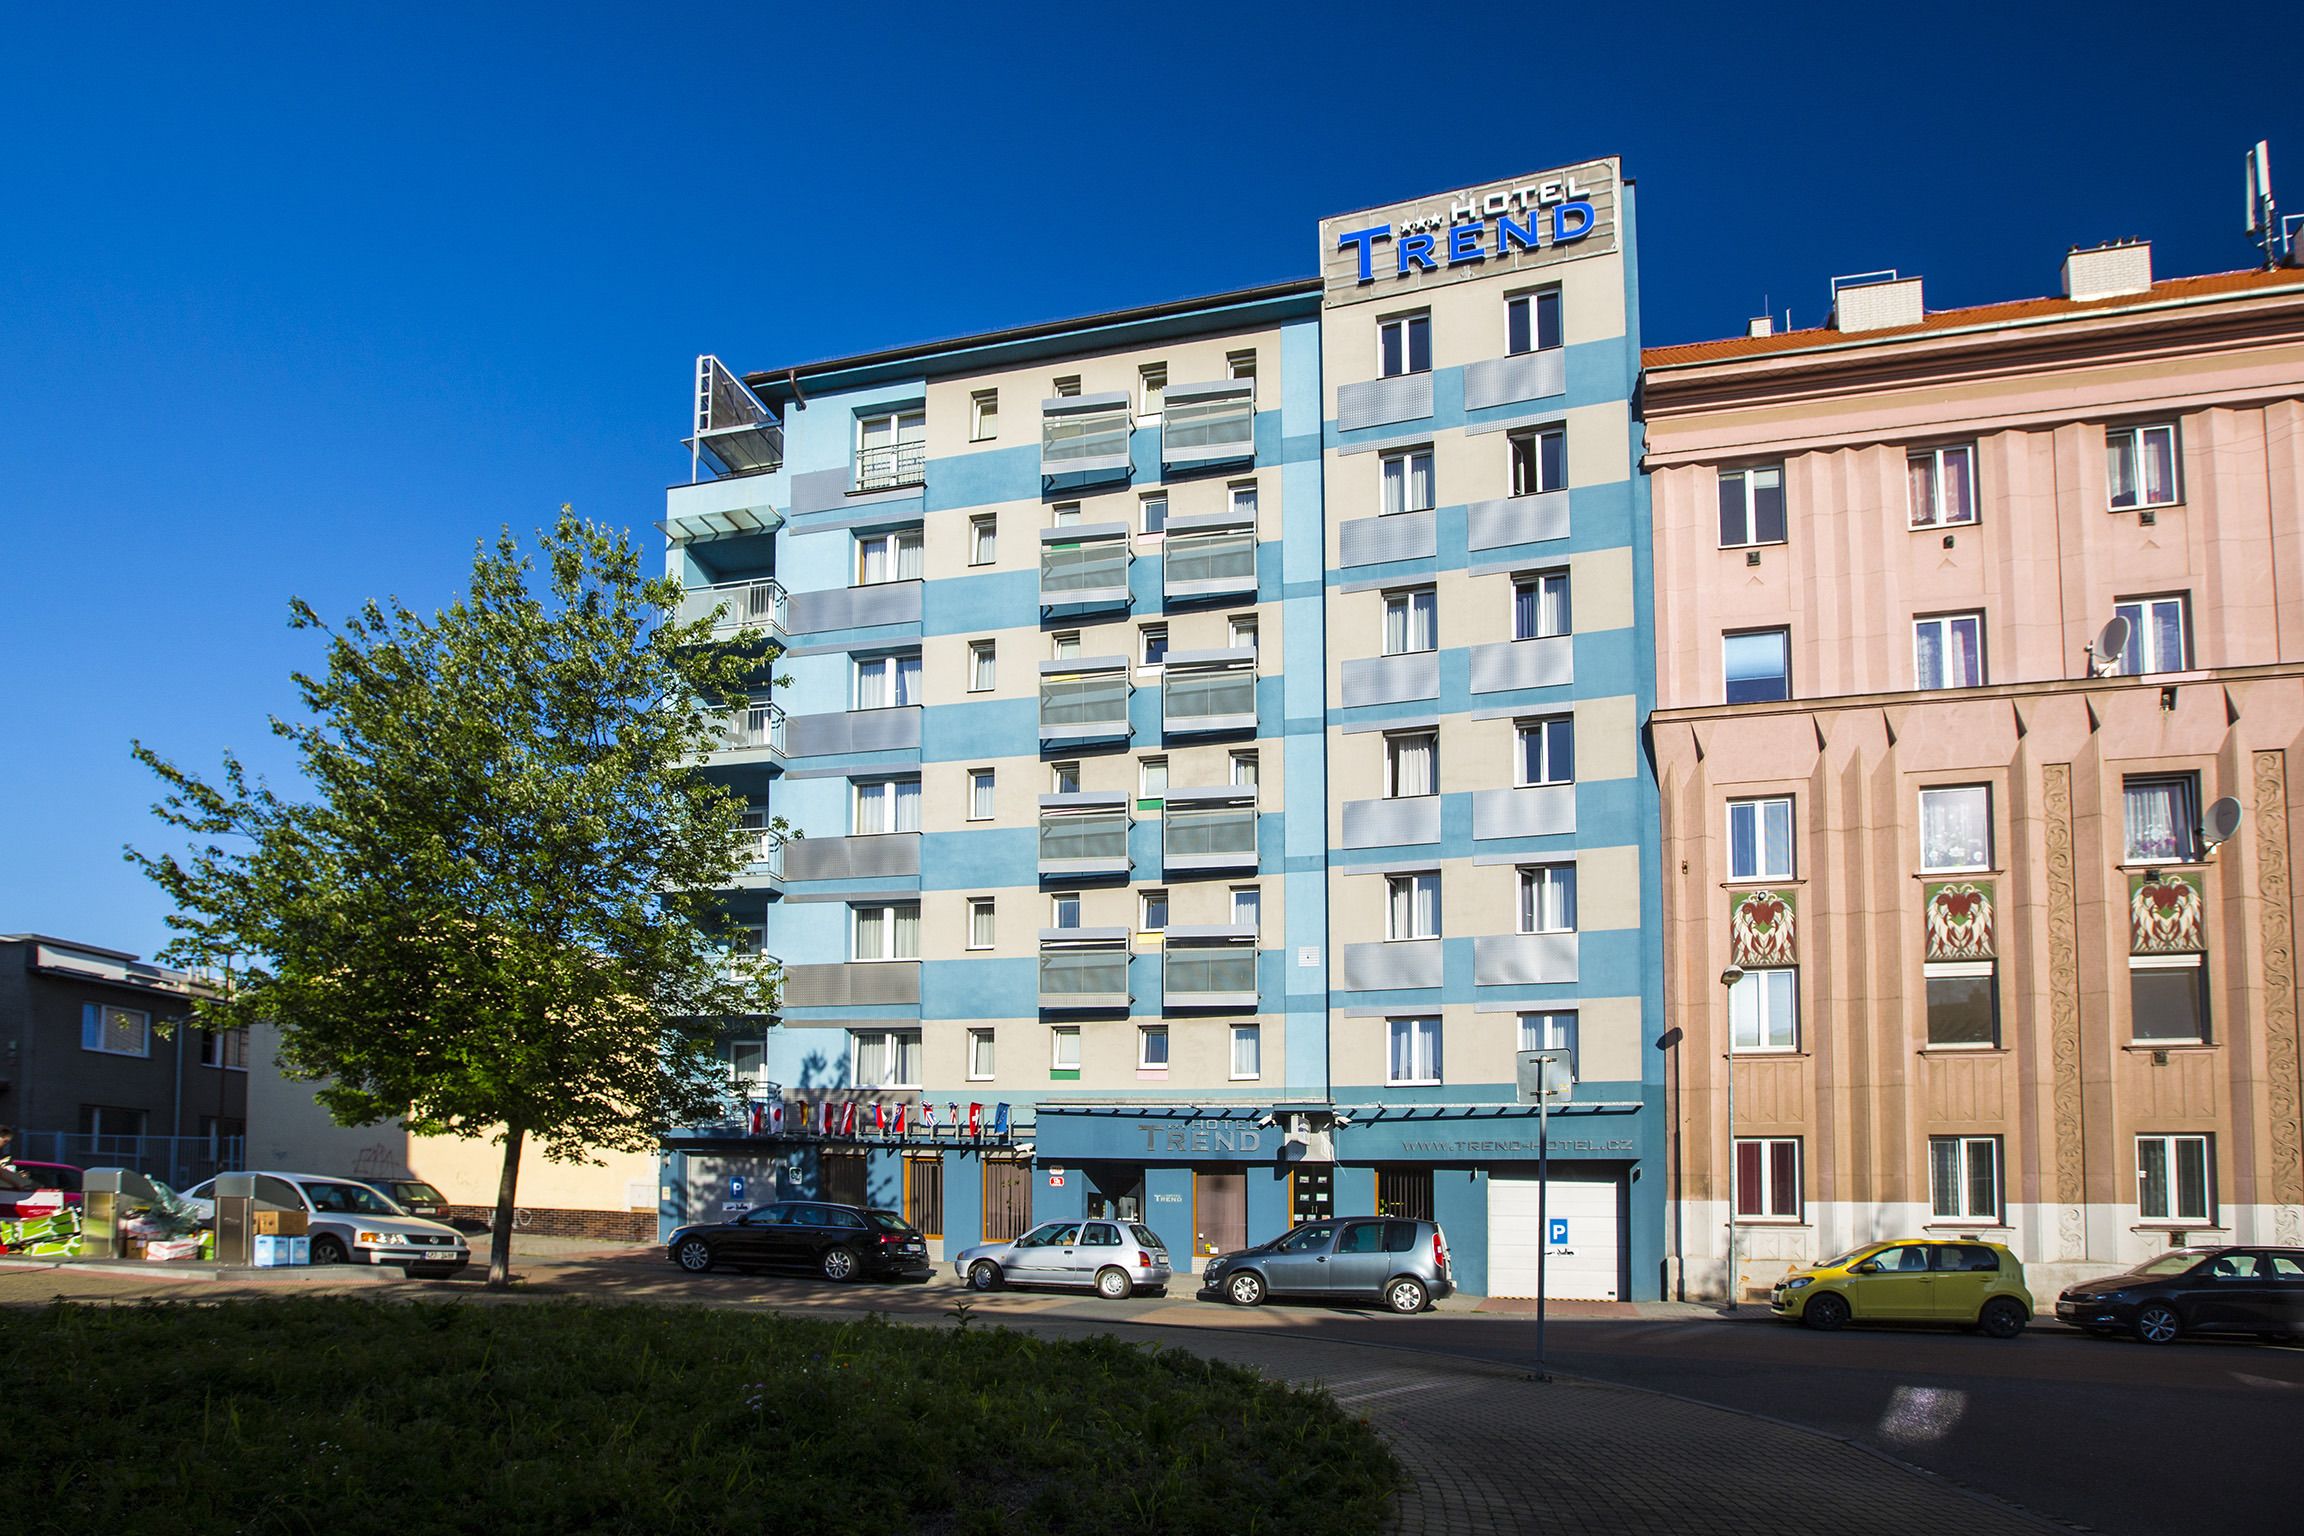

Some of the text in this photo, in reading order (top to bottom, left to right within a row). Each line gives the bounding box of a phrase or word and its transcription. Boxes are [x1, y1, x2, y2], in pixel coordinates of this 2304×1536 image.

[1451, 177, 1591, 222] HOTEL
[1338, 201, 1596, 283] TREND
[1192, 1120, 1260, 1130] HOTEL
[1138, 1125, 1261, 1152] TREND
[733, 1182, 742, 1195] P
[1154, 1194, 1183, 1202] TREND
[1553, 1225, 1566, 1240] P
